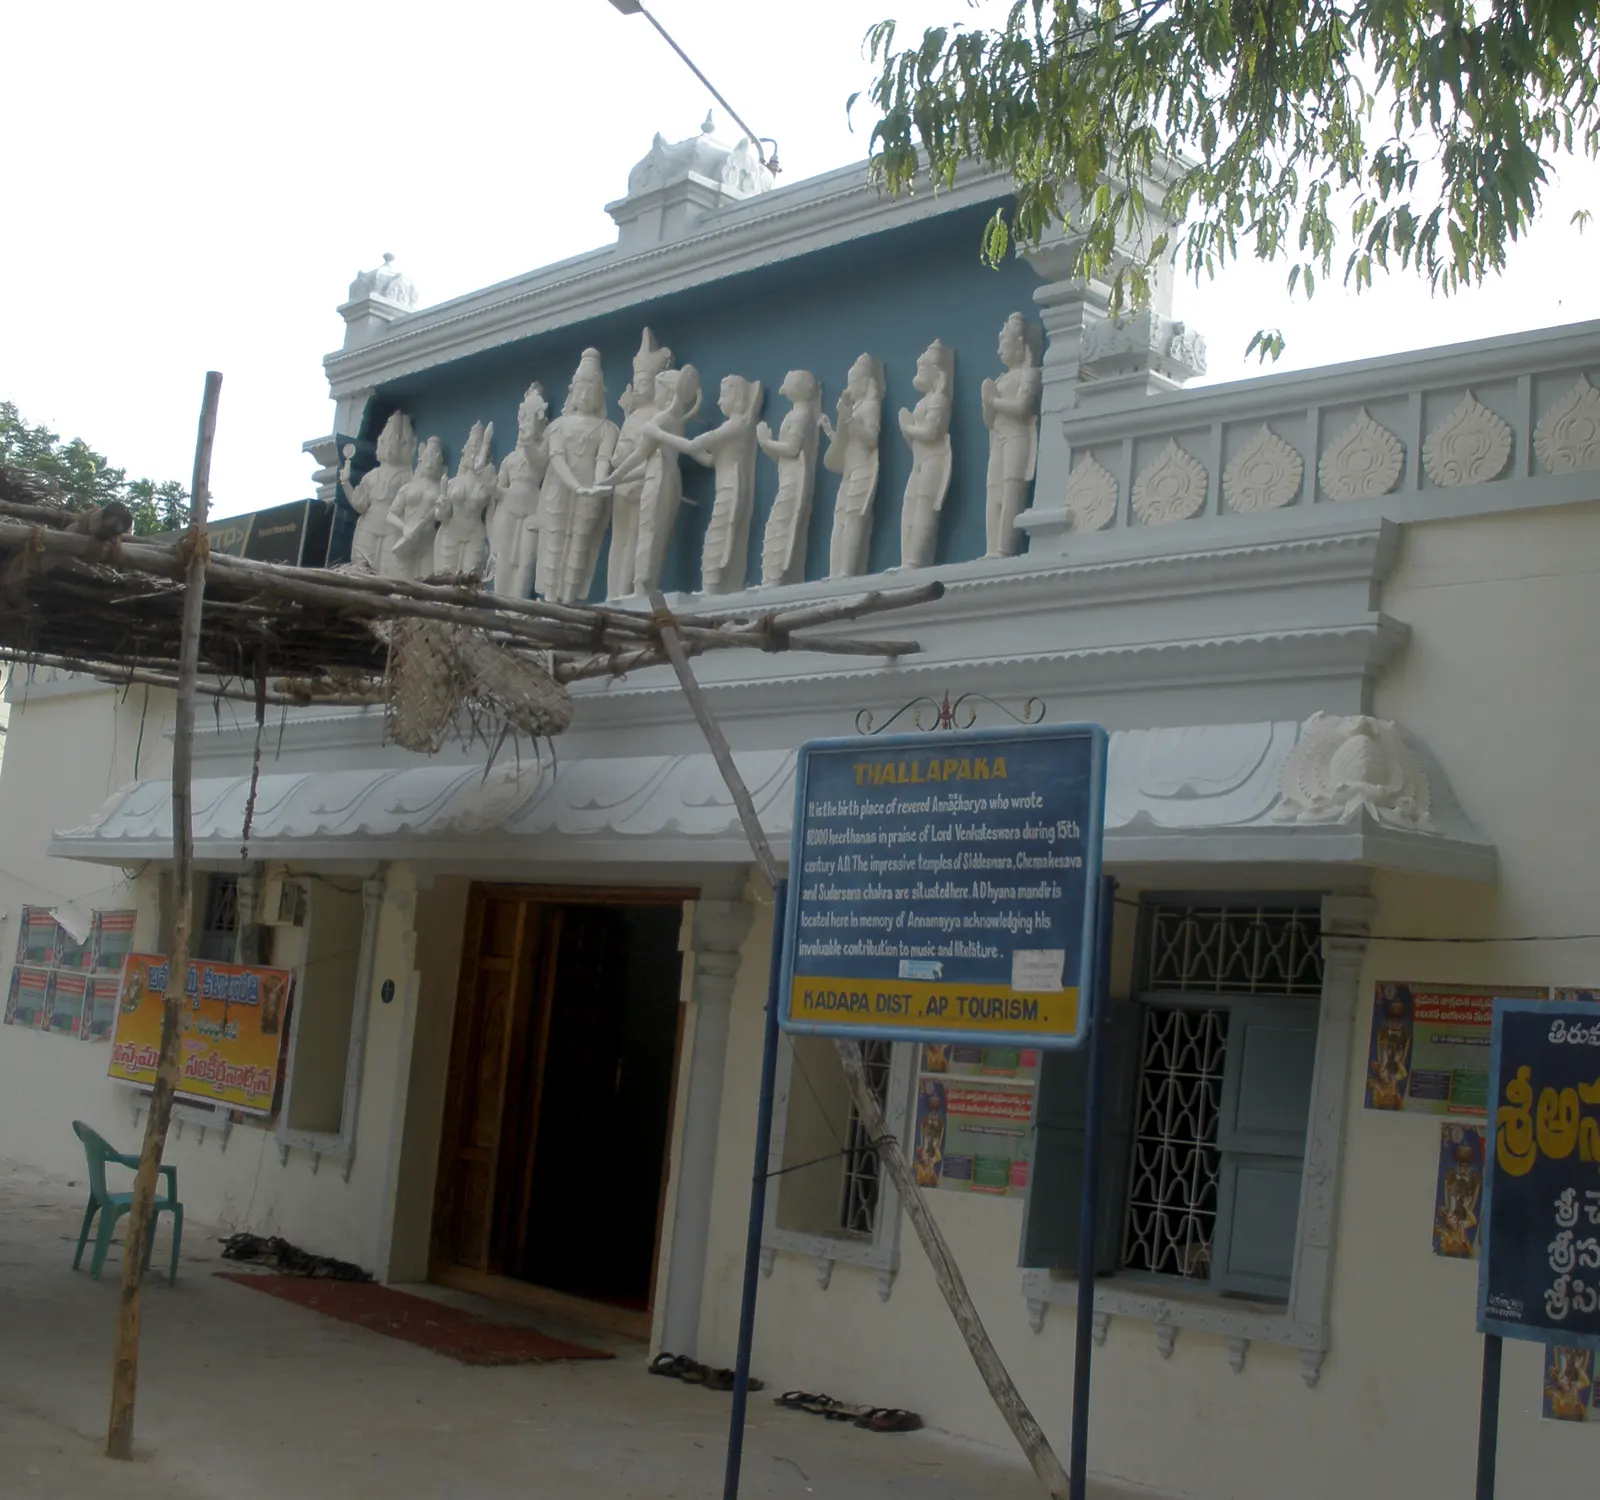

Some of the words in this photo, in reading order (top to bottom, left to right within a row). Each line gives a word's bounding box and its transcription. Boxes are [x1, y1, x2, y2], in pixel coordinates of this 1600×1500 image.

[853, 756, 1007, 785] THALLAPAKA
[808, 801, 815, 817] It
[816, 801, 822, 817] is
[822, 800, 837, 817] the
[838, 799, 859, 816] birth
[860, 798, 885, 820] place
[886, 797, 897, 815] of
[897, 796, 930, 814] revered
[988, 793, 1009, 809] who
[1011, 791, 1043, 810] wrote
[829, 827, 877, 846] keerthanas
[878, 826, 887, 844] in
[888, 825, 917, 848] praise
[918, 824, 930, 842] of
[931, 823, 952, 841] Lord
[954, 823, 1021, 841] Venkateswara
[1022, 821, 1055, 844] during
[1056, 820, 1080, 839] 15th
[804, 855, 835, 876] century
[852, 854, 868, 871] The
[870, 853, 916, 876] impressive
[918, 853, 953, 874] temples
[954, 852, 963, 869] of
[802, 883, 818, 900] and
[818, 882, 862, 901] Sudarsana
[863, 882, 893, 900] chakra
[894, 888, 909, 900] are
[911, 881, 950, 900] situated
[972, 881, 979, 899] A
[980, 880, 1016, 904] Dhyana
[1017, 881, 1051, 900] mandir
[1052, 880, 1062, 899] is
[801, 910, 830, 928] located
[830, 910, 849, 927] here
[850, 910, 858, 927] in
[859, 915, 894, 932] memory
[895, 910, 905, 927] of
[907, 911, 961, 932] Annamayya
[962, 910, 1033, 934] acknowledging
[1034, 911, 1052, 928] his
[799, 938, 842, 956] invaluable
[843, 939, 898, 956] contribution
[899, 940, 909, 956] to
[910, 941, 935, 957] music
[937, 940, 953, 957] and
[803, 989, 870, 1013] KADAPA
